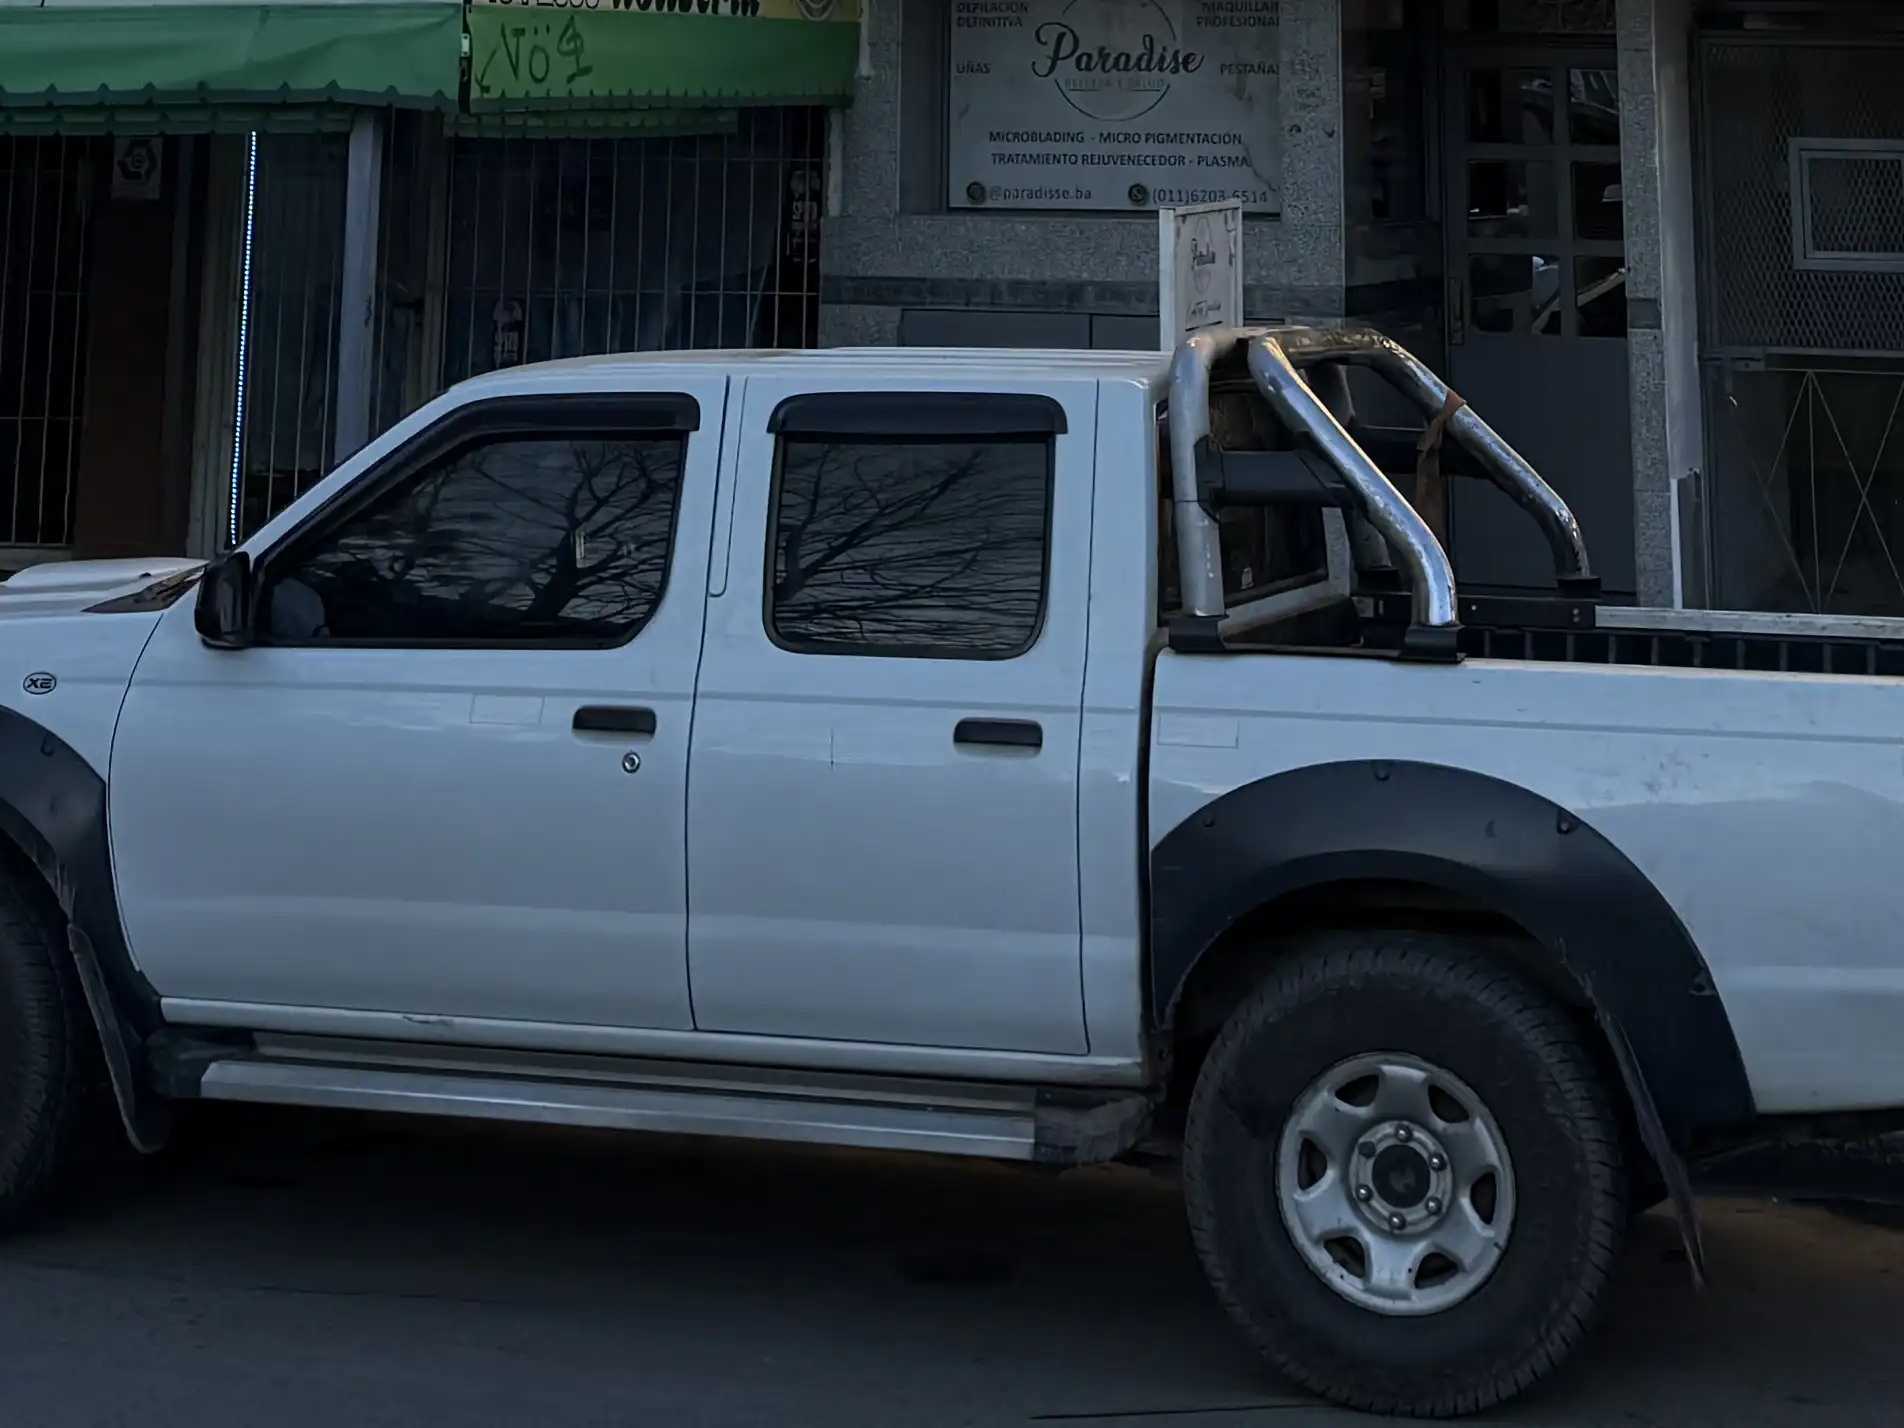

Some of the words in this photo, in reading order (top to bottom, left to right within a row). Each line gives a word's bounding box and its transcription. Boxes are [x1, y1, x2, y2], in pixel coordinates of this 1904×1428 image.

[1031, 20, 1206, 79] Paradise
[956, 59, 991, 75] UÑAS
[988, 130, 1085, 144] MICROBLADING
[1099, 131, 1141, 144] MICRO
[1144, 129, 1243, 145] PIGMENTACIÓN
[991, 152, 1078, 166] TRATAMIENTO
[1080, 152, 1186, 167] REJUVENECEDOR
[1197, 154, 1251, 168] PLASMA
